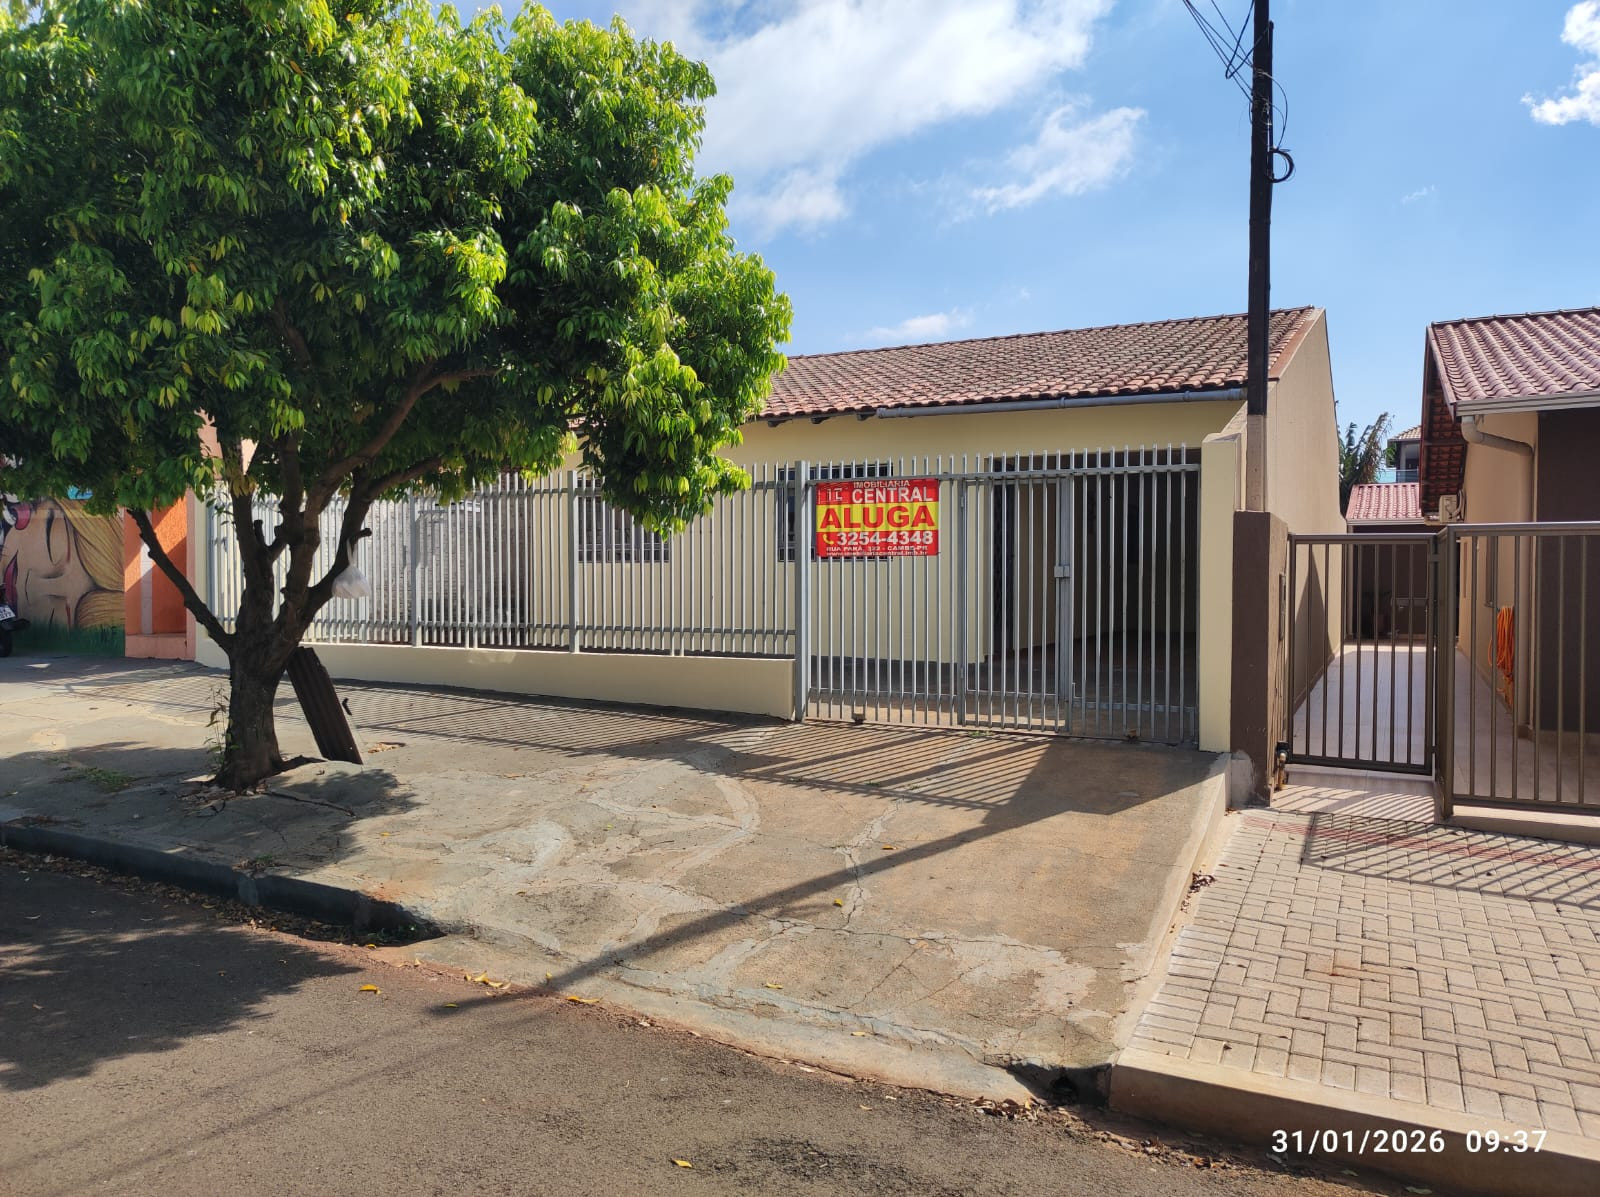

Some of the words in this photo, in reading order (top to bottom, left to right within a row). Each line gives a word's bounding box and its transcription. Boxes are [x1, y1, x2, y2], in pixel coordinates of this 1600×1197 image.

[851, 487, 933, 504] CENTRAL
[820, 505, 935, 529] ALUGA
[837, 531, 933, 545] 3254-4348
